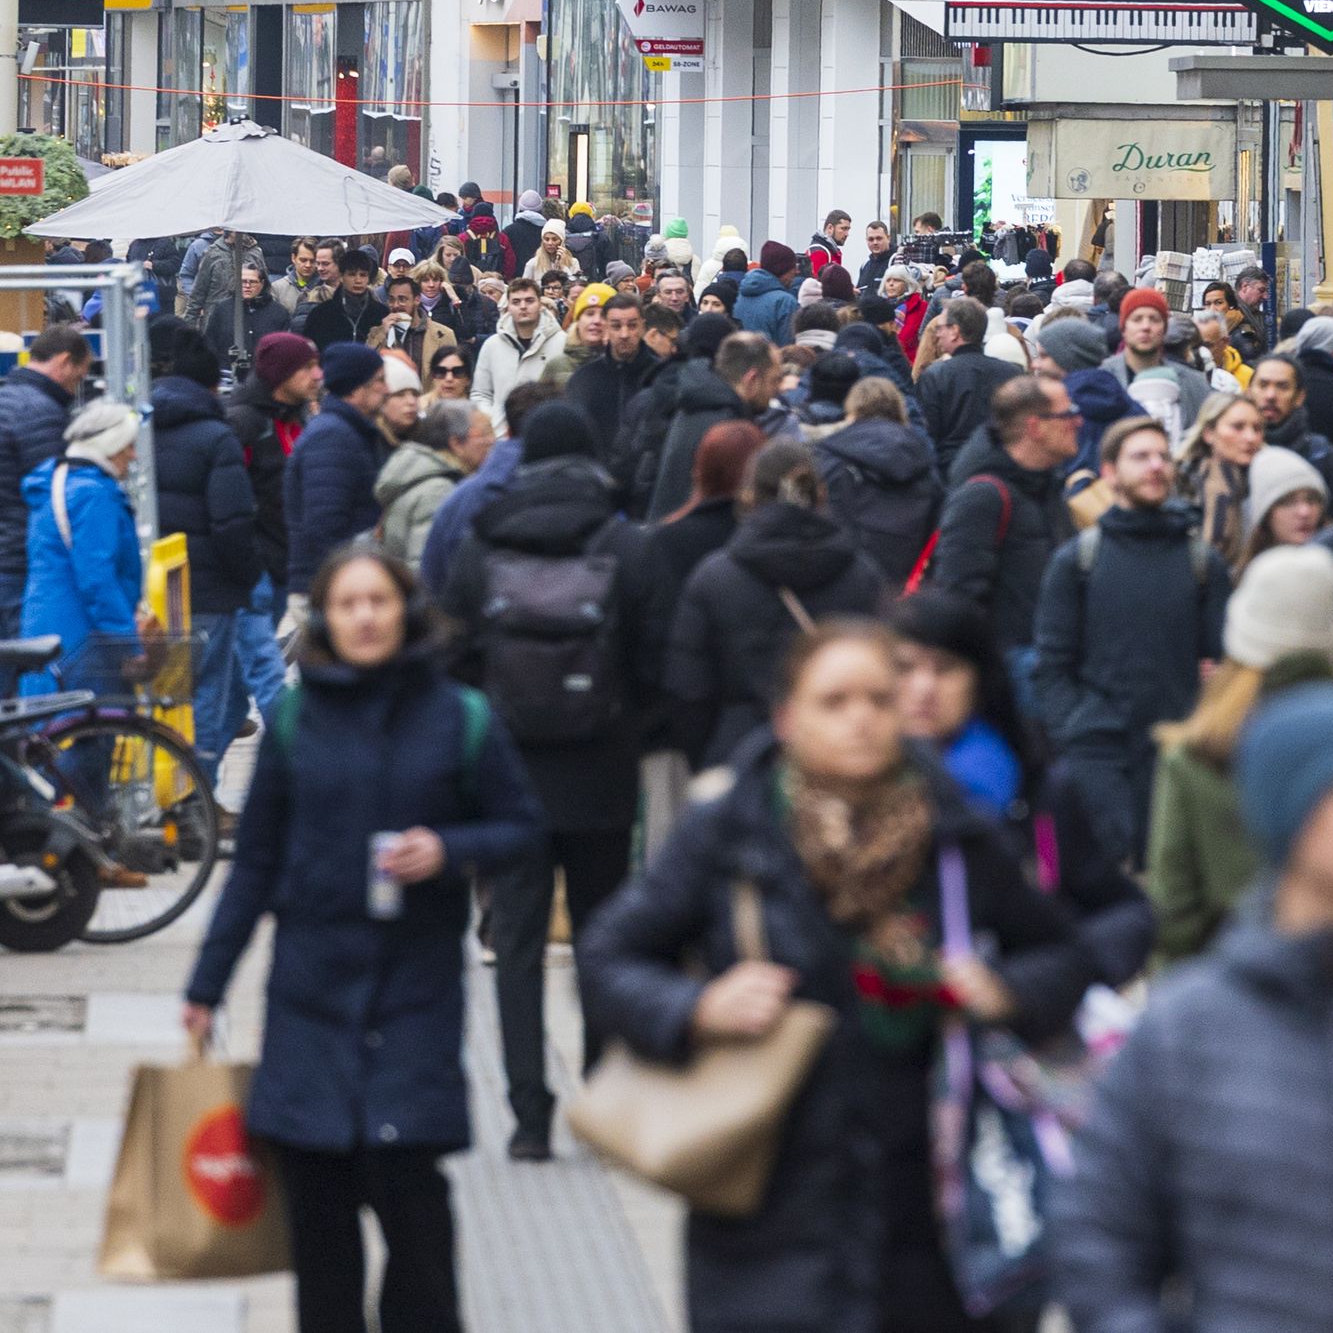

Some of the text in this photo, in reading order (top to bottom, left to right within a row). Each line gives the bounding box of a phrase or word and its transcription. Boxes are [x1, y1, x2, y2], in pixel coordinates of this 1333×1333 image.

[646, 4, 697, 14] BAWAG
[653, 43, 701, 51] GELDAUTOMAT
[1112, 141, 1217, 173] Duran
